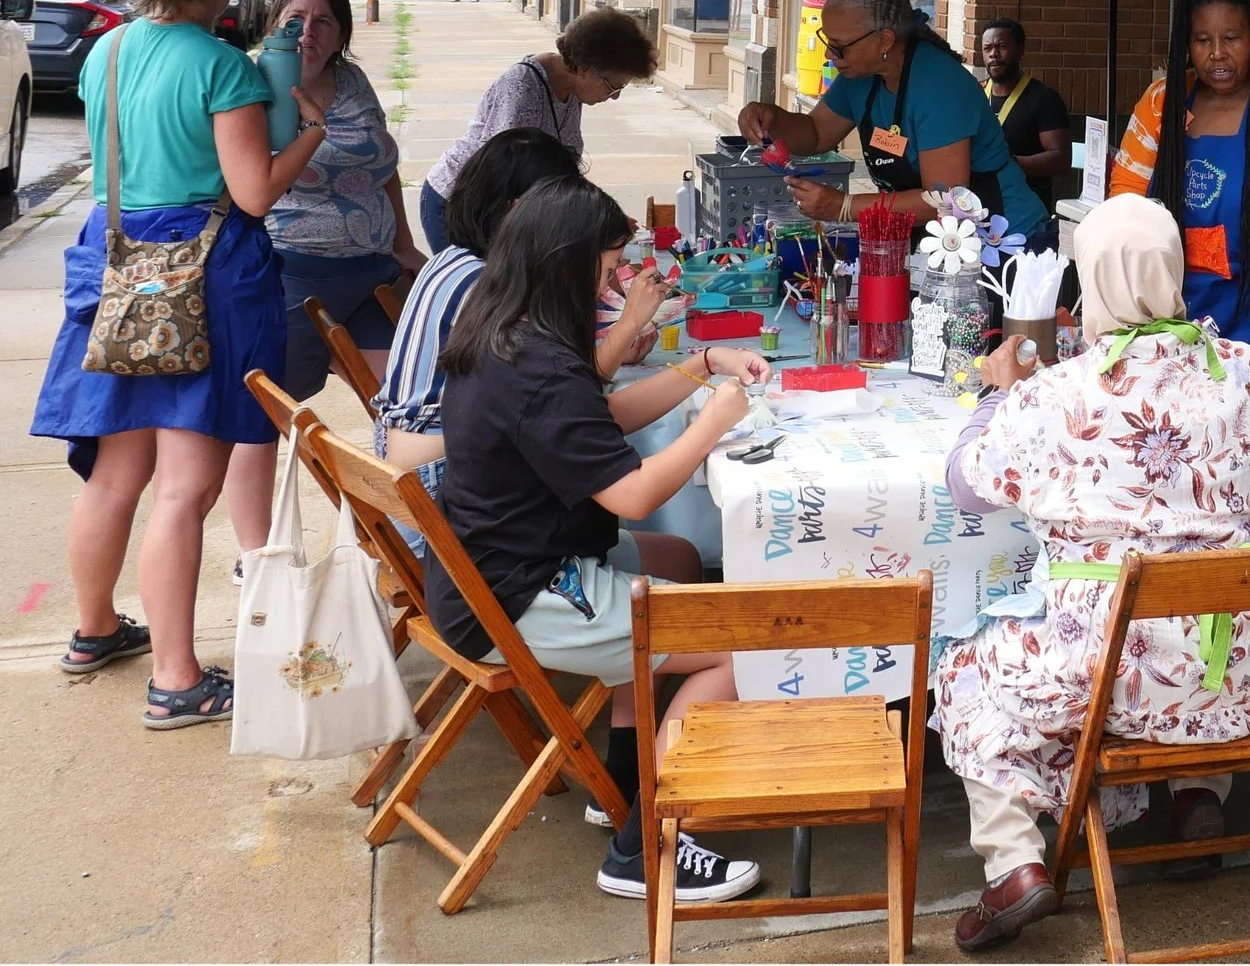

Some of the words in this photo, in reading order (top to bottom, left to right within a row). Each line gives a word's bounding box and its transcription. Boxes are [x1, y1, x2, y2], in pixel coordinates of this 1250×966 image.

[1187, 166, 1214, 180] Upcycle
[1189, 178, 1207, 189] Parts
[1186, 188, 1205, 200] Shop
[764, 486, 797, 562] Dance
